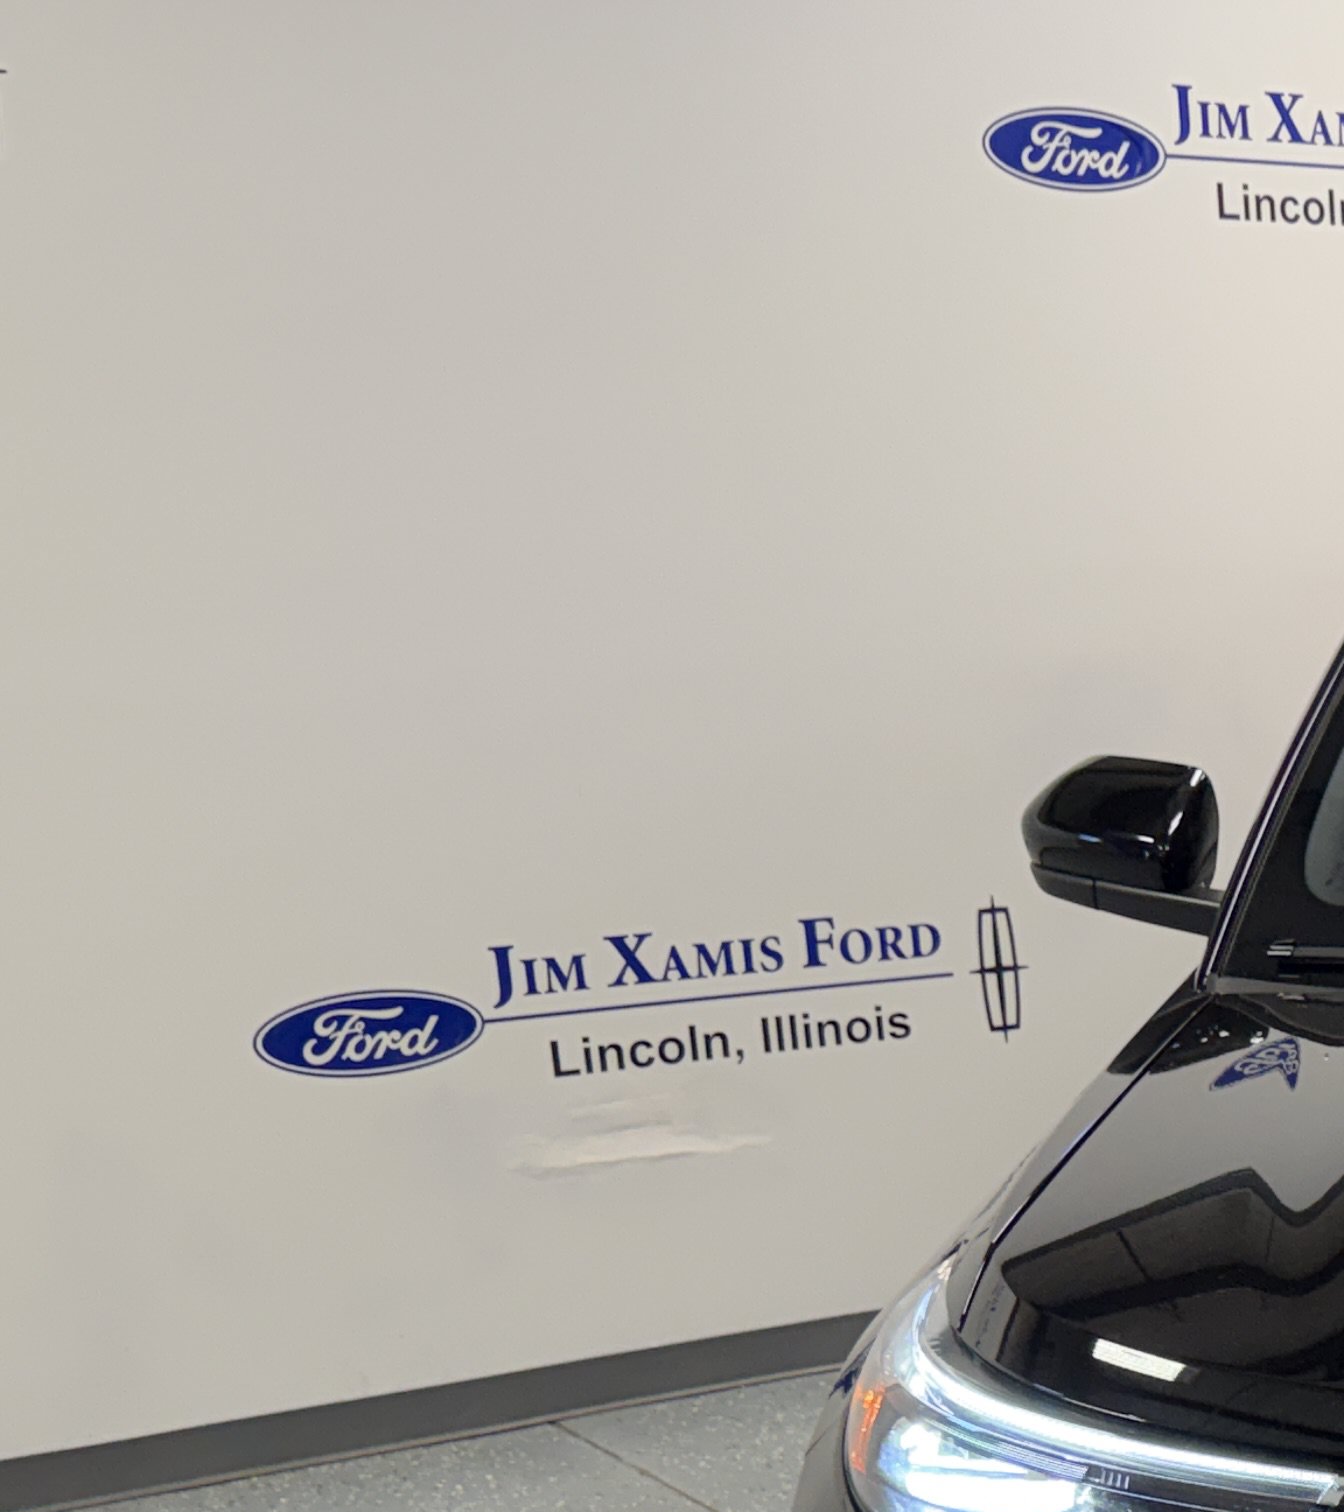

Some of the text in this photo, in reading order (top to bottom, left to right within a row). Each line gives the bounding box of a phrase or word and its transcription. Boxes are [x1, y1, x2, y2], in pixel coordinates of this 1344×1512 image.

[1171, 84, 1253, 146] JIM
[1020, 119, 1129, 179] Ford
[487, 916, 942, 1009] JIM XAMIS FORD
[302, 1005, 438, 1066] Ford
[549, 1004, 912, 1078] Lincoln, Illinois
